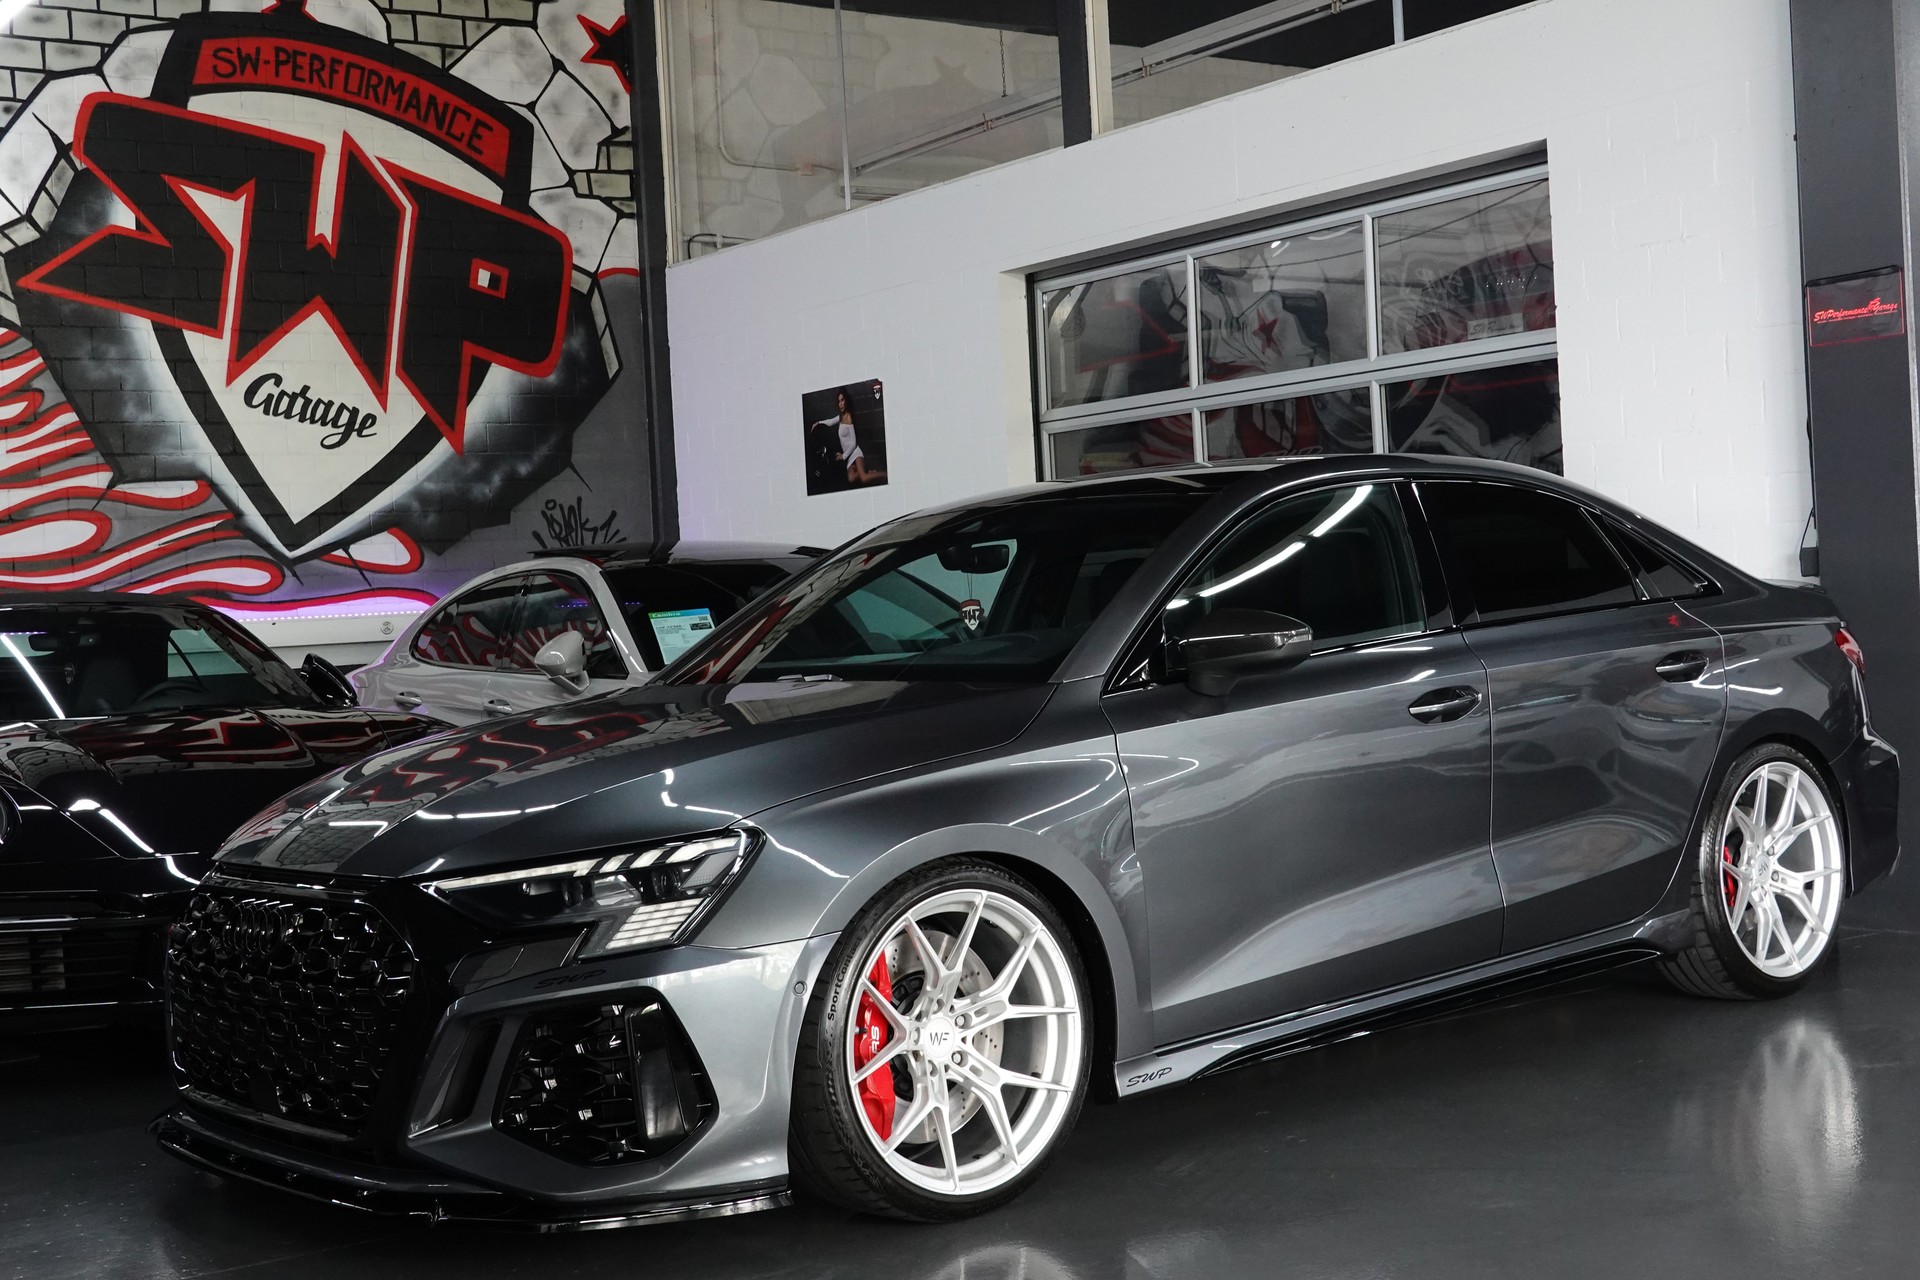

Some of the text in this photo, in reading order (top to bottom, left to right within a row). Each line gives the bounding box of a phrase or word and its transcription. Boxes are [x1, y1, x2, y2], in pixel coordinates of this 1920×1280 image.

[210, 46, 494, 156] SW-PERFORMANCE
[16, 91, 573, 456] SWP
[243, 372, 378, 450] Garage
[1126, 1067, 1172, 1088] SWP
